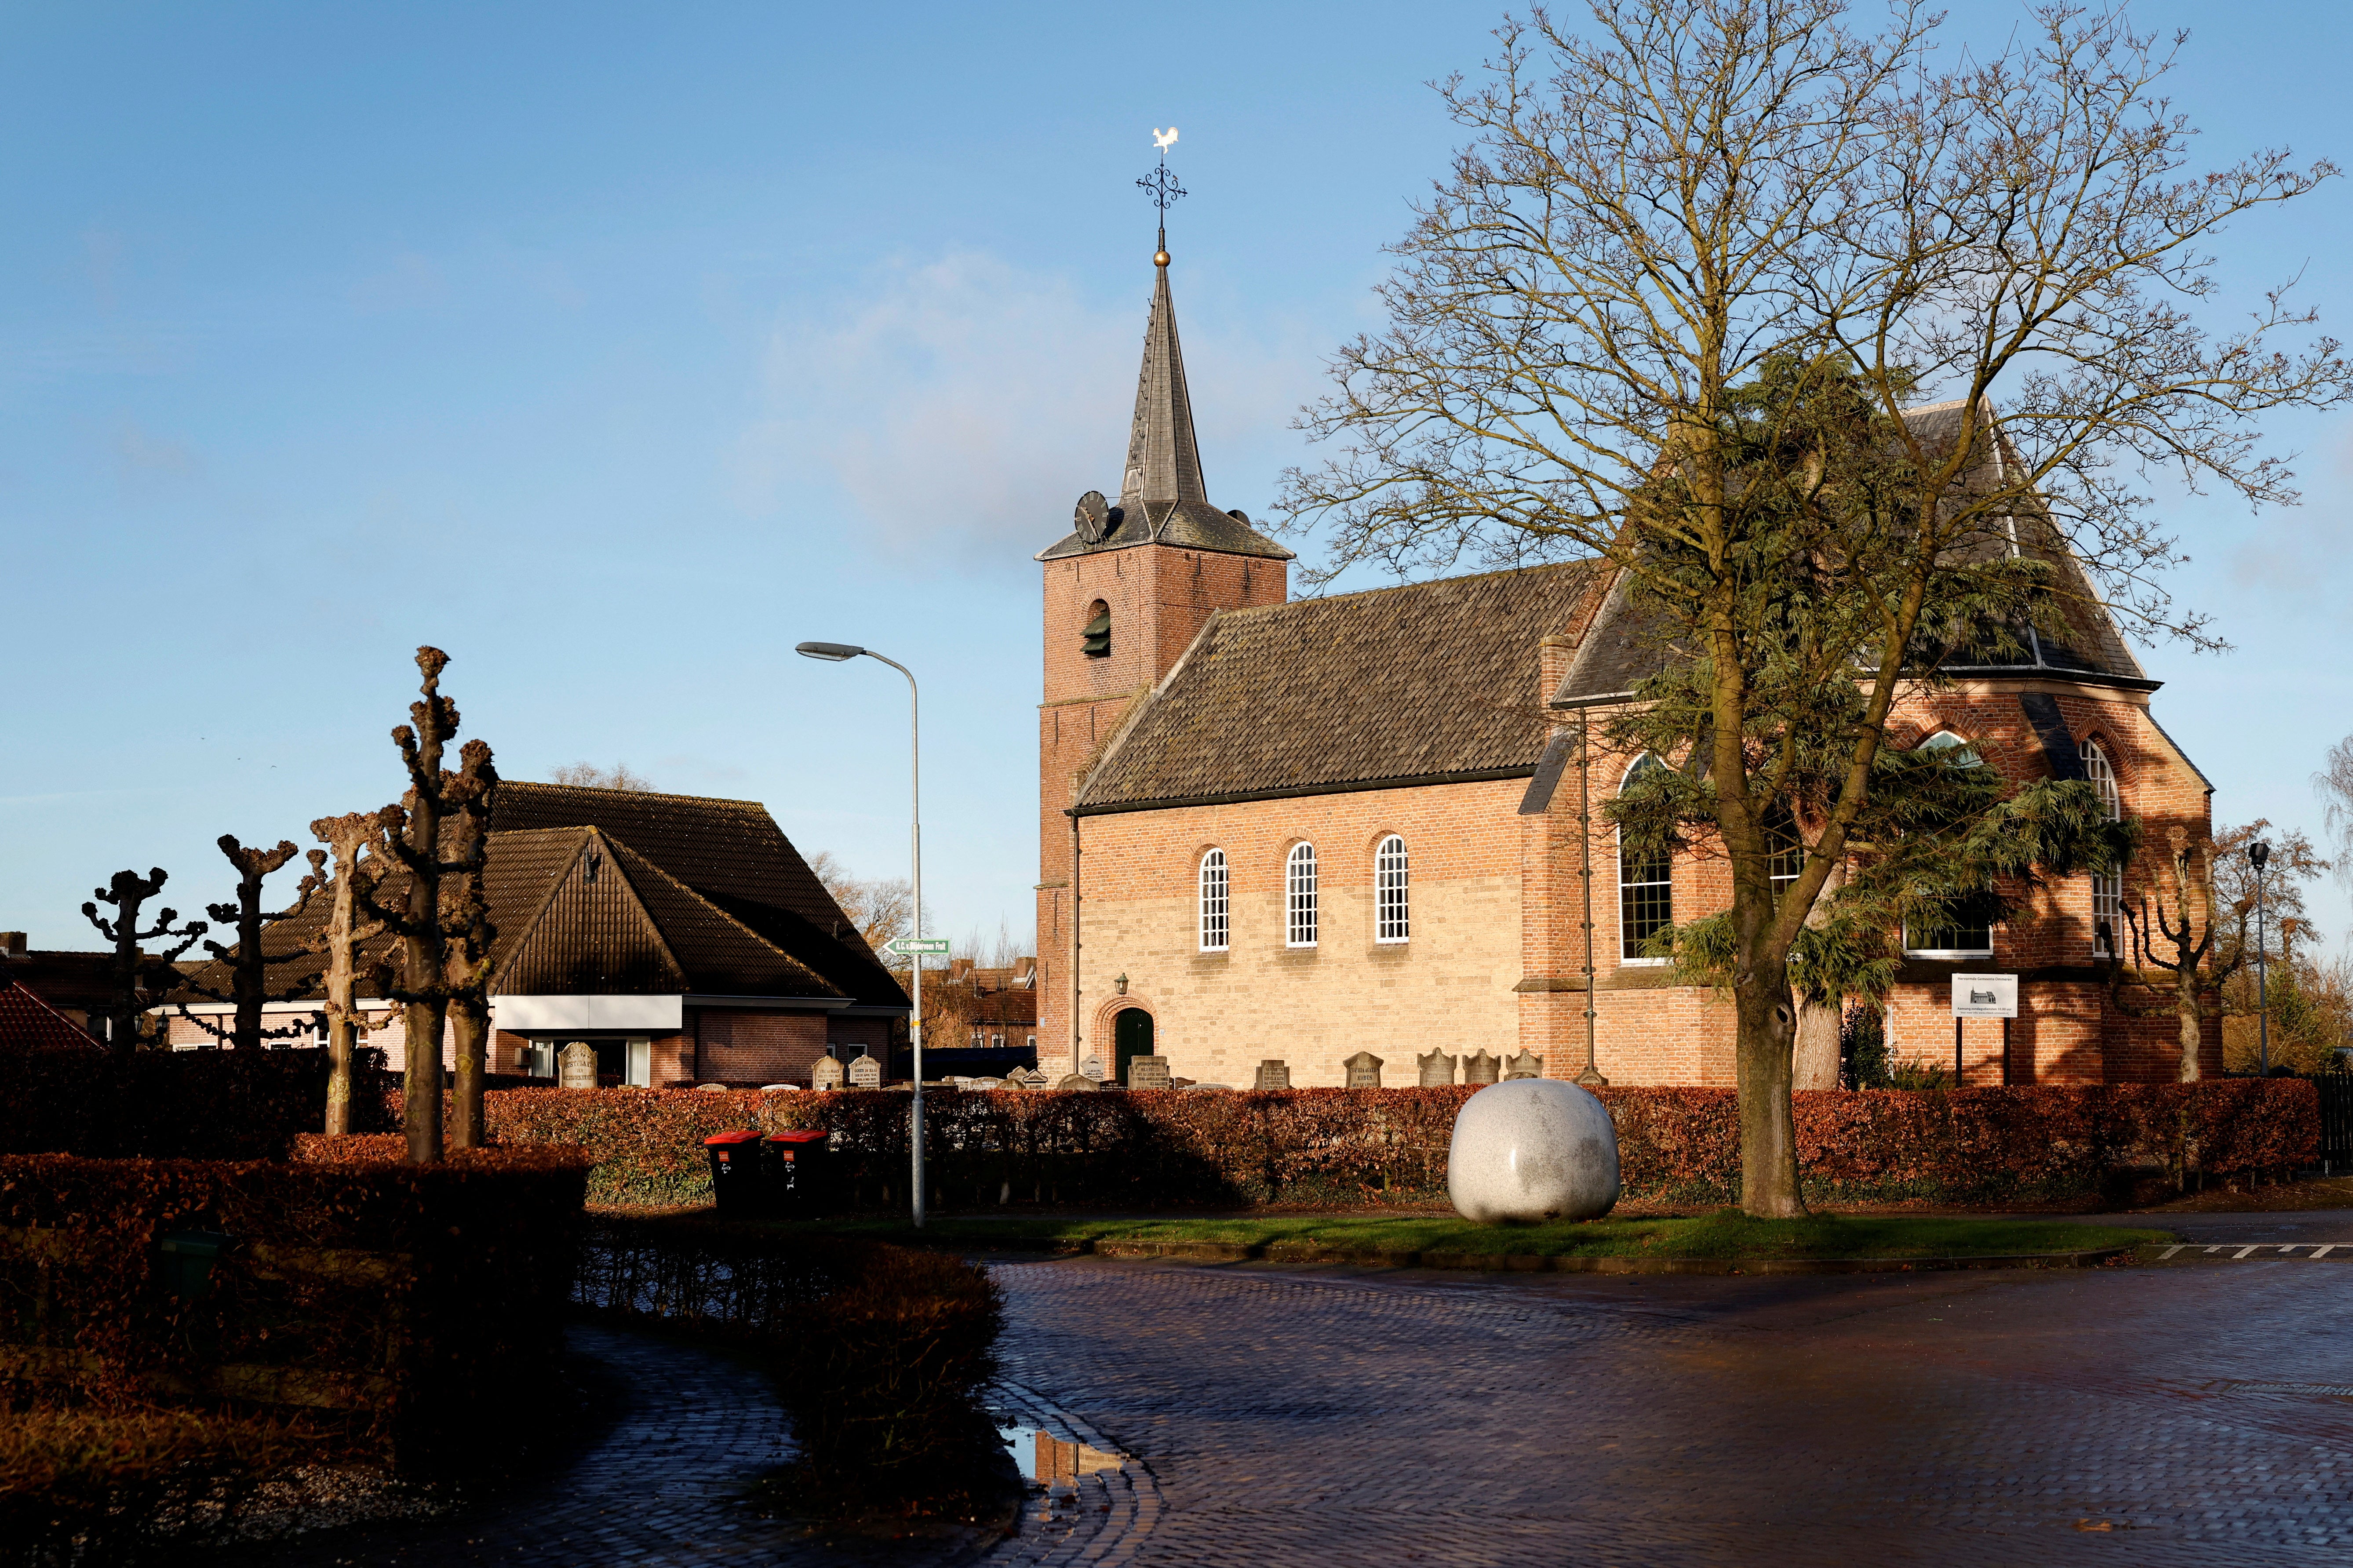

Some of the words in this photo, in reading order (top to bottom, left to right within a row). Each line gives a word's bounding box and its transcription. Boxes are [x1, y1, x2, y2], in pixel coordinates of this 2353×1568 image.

[910, 942, 934, 952] Blijderveen
[936, 942, 946, 950] Fruit
[564, 1061, 596, 1070] RUSTPLAATS
